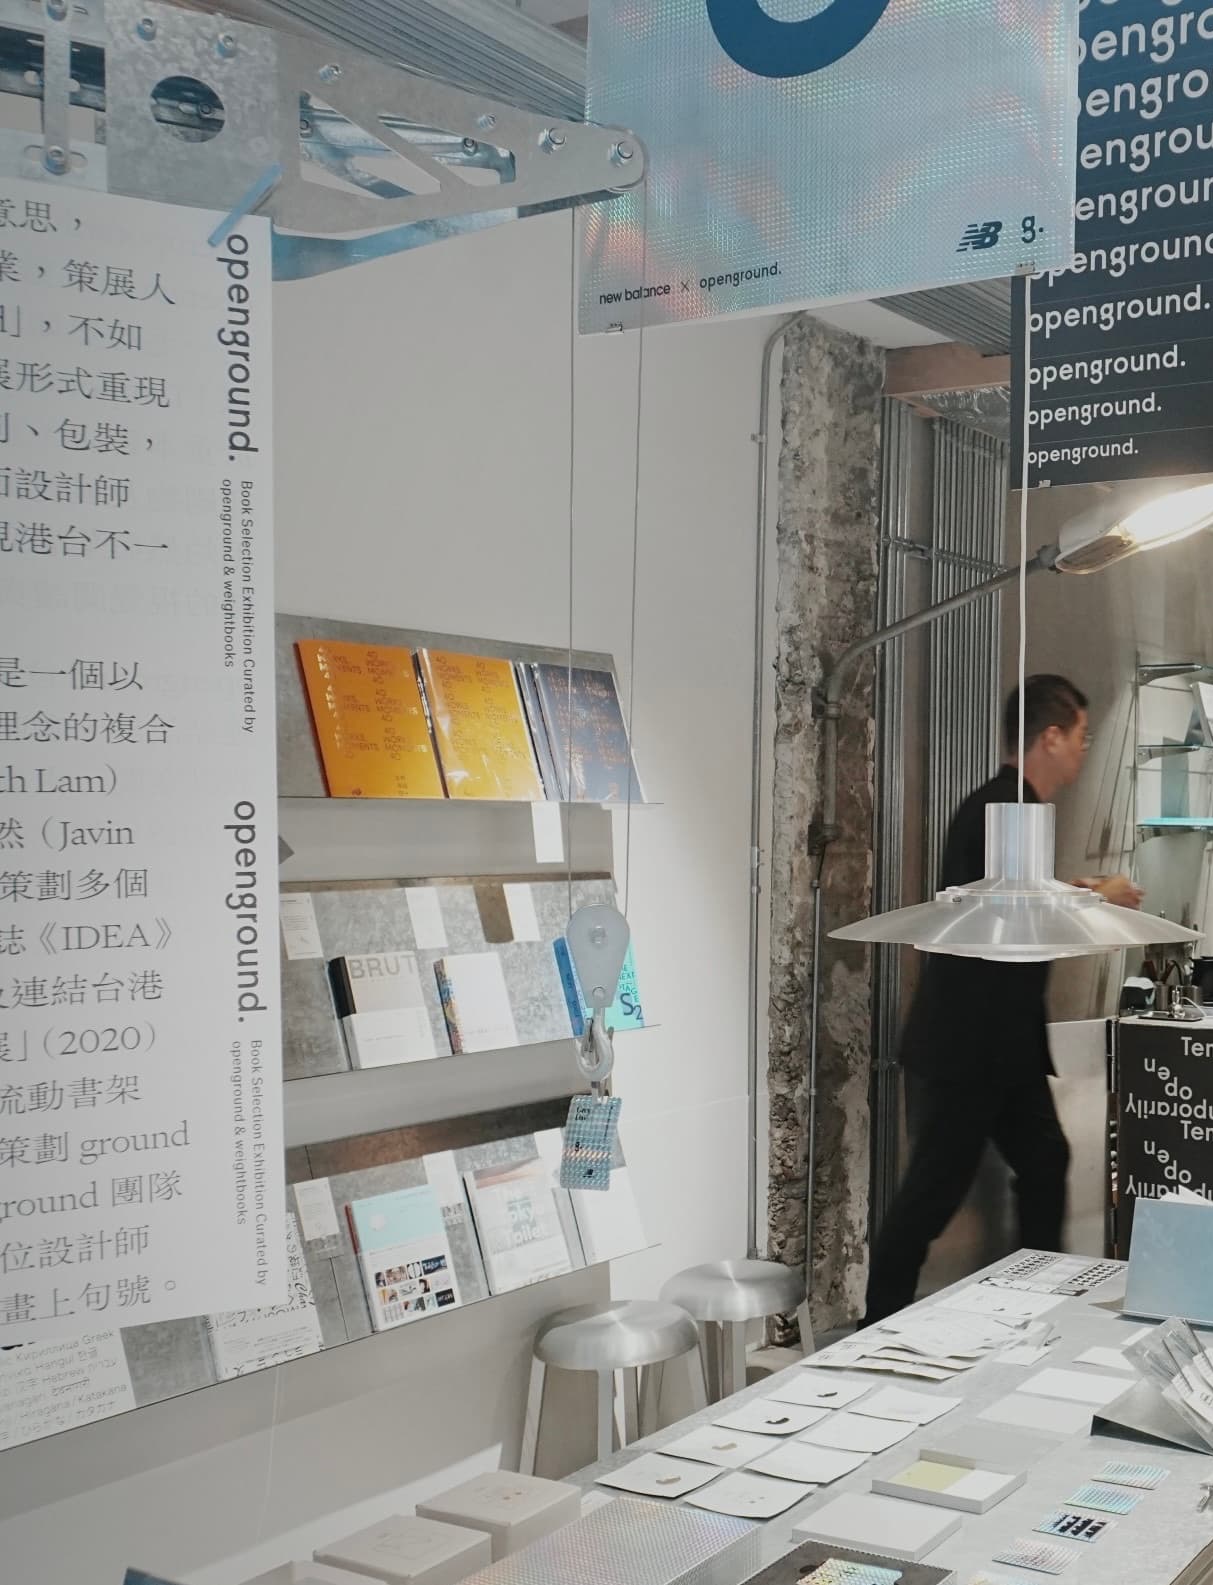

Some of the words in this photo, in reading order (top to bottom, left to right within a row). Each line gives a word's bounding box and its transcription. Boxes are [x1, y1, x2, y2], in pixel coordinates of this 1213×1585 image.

[599, 291, 622, 305] new
[624, 283, 671, 302] balance
[699, 262, 782, 292] openground.
[0, 305, 143, 352] 」，不如
[1028, 284, 1211, 339] openground.
[216, 233, 259, 463] openground.
[1027, 344, 1186, 390] openground.
[0, 411, 155, 457] 、包裝，
[1027, 391, 1163, 430] openground.
[1026, 437, 1139, 469] openground.
[219, 479, 235, 563] openground
[241, 480, 254, 515] Book
[223, 566, 235, 577] &
[241, 518, 255, 583] Selection
[220, 580, 236, 668] weightbooks
[242, 587, 256, 655] Exhibition
[243, 659, 257, 713] Curated
[241, 716, 257, 734] by
[223, 800, 267, 1023] openground.
[0, 970, 166, 1010] 連結台港
[0, 1022, 157, 1062] 」（2020）
[250, 1039, 263, 1073] Book
[230, 1041, 246, 1123] openground
[233, 1126, 246, 1137] &
[251, 1077, 265, 1140] Selection
[79, 1119, 191, 1165] ground
[0, 1181, 99, 1222] round
[111, 1170, 184, 1208] 團隊
[232, 1139, 248, 1225] weightbooks
[253, 1143, 266, 1210] Exhibition
[0, 1224, 151, 1275] 位設計師
[255, 1213, 268, 1267] Curated
[255, 1270, 269, 1286] by
